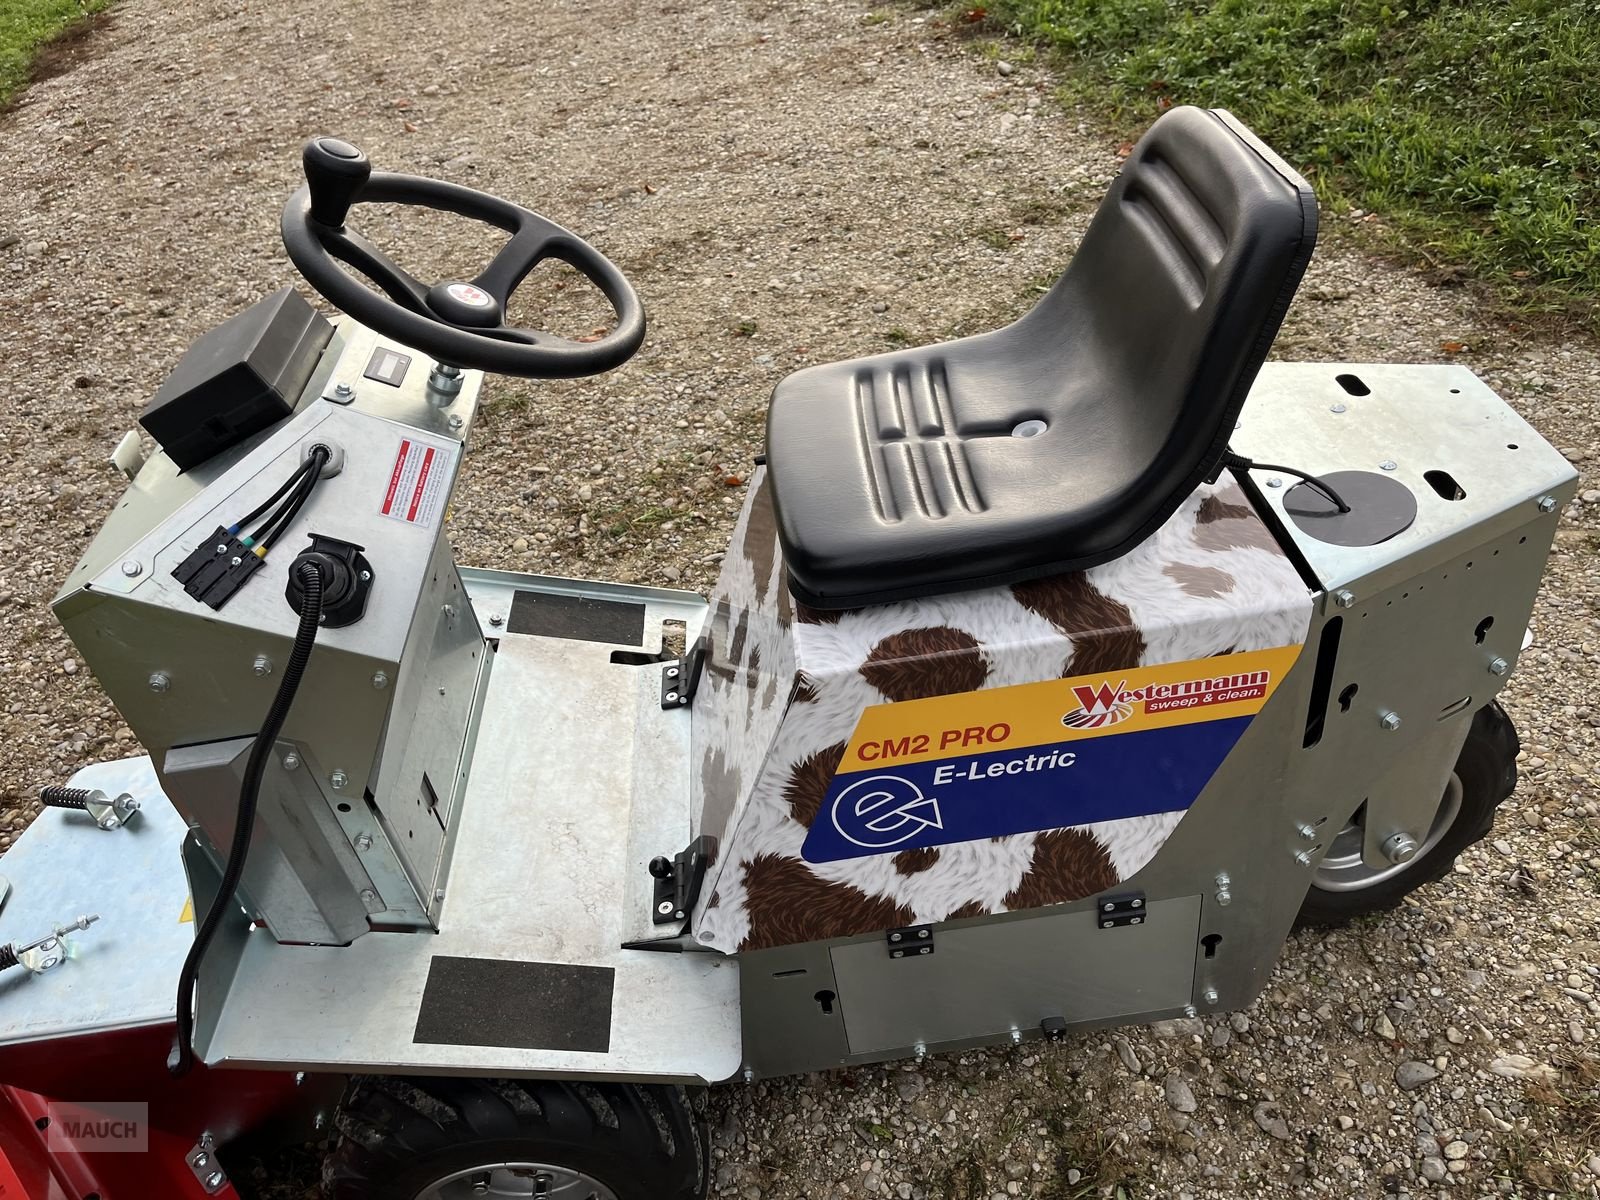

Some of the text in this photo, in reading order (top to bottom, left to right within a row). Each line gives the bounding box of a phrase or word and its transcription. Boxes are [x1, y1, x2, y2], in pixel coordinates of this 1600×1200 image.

[412, 493, 420, 507] Notice
[1071, 670, 1270, 714] Westermann
[1150, 687, 1262, 711] sweep & clean.
[857, 723, 1011, 762] CM2 PRO
[933, 750, 1076, 785] E-Lectric
